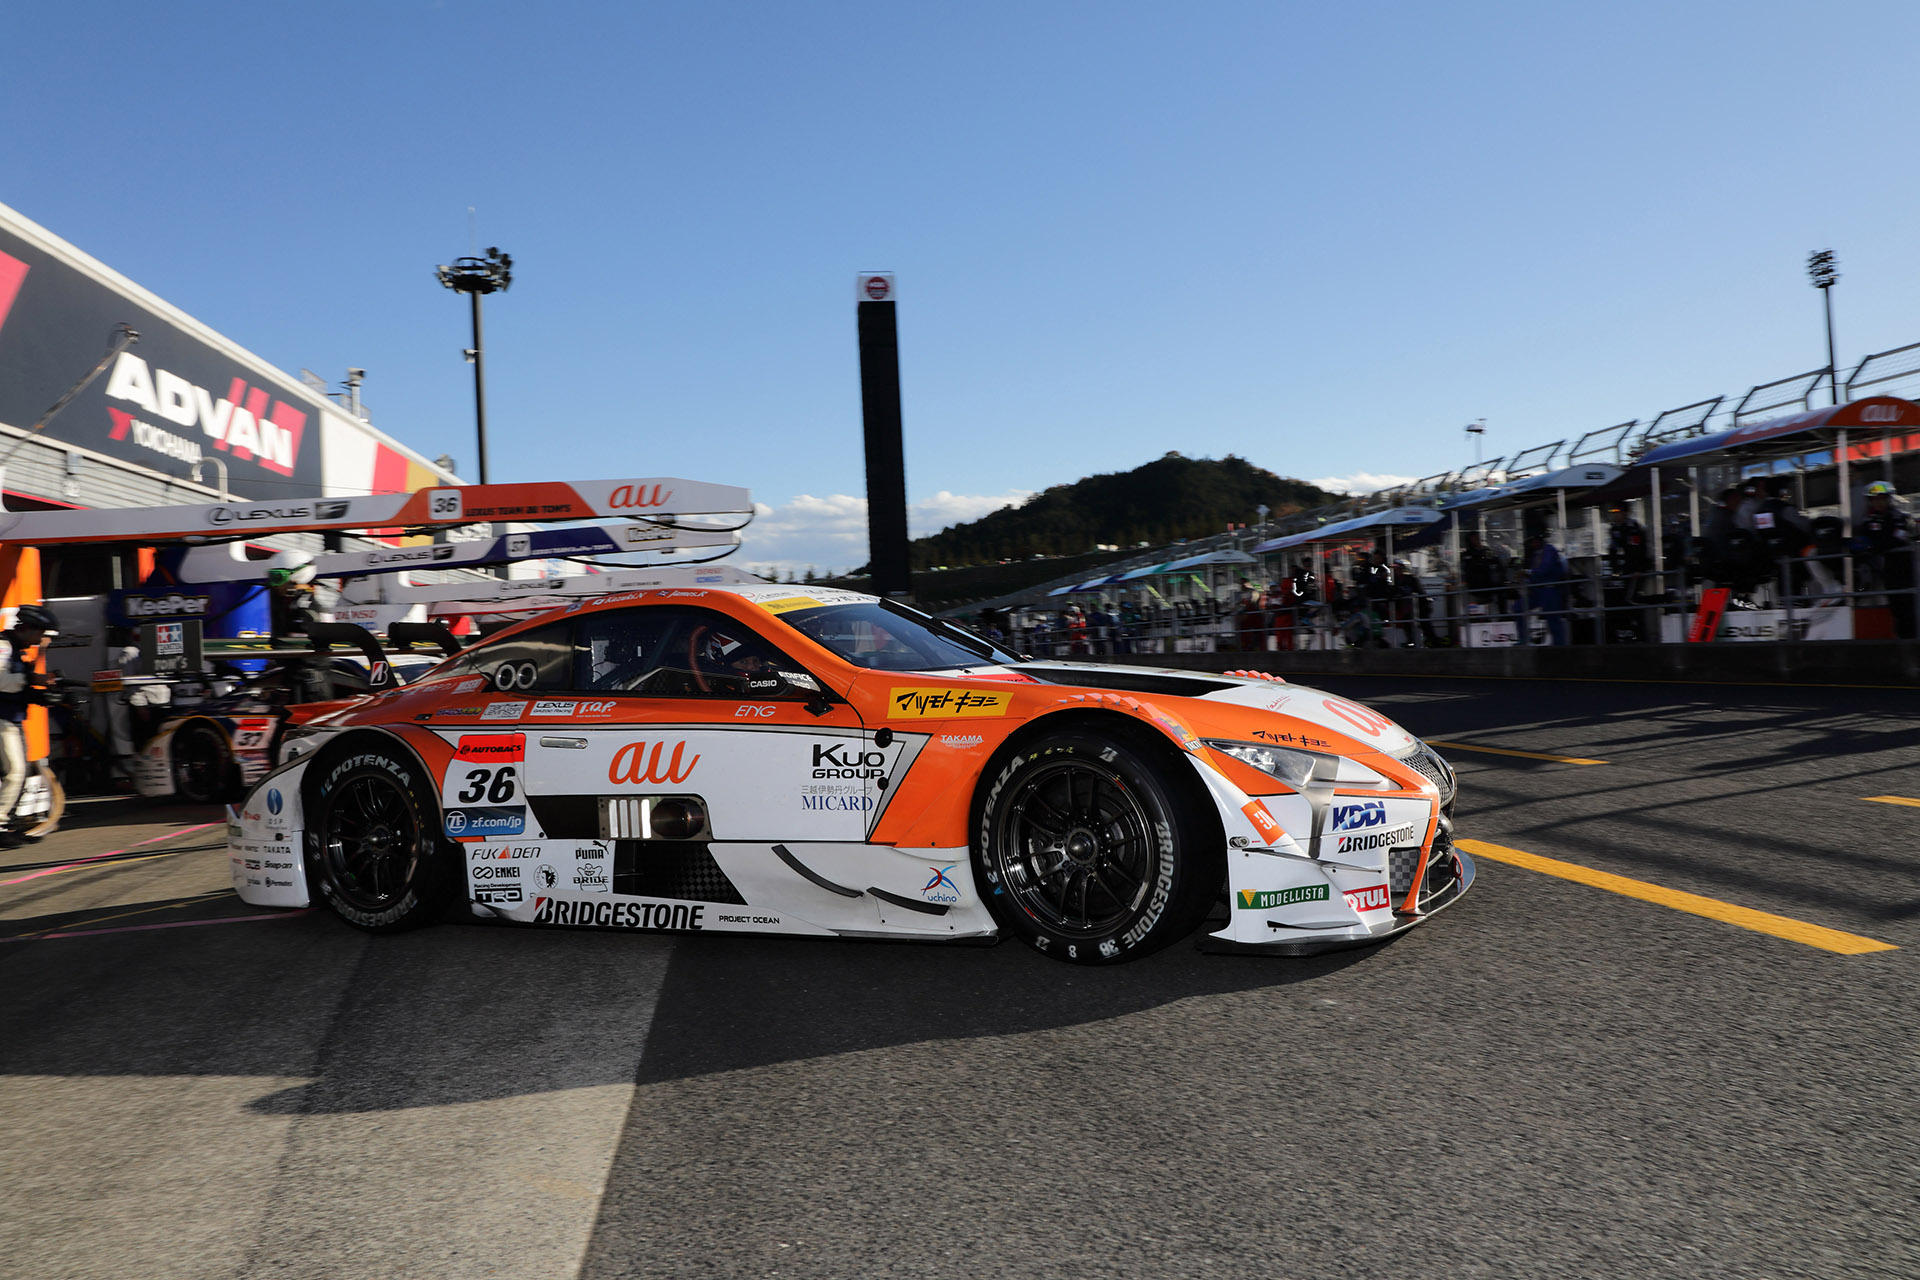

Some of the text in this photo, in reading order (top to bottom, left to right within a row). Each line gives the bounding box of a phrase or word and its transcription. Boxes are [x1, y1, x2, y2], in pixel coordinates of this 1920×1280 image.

[105, 351, 294, 469] ADVAN
[433, 497, 458, 513] 36
[608, 484, 673, 509] au
[236, 507, 311, 521] LEXUS
[127, 594, 209, 616] KeePer
[750, 679, 778, 688] CASIO
[896, 690, 999, 715] マツモトキヨシ
[471, 744, 522, 754] AUTOBACS
[332, 754, 411, 788] POTENZA
[608, 741, 701, 785] au
[812, 768, 885, 779] GROUP
[458, 766, 516, 804] 36
[802, 795, 873, 811] MICARD
[981, 755, 1025, 867] POTENZA
[471, 816, 522, 829] zf.com/jp
[1332, 801, 1386, 831] KDDI
[1338, 825, 1414, 854] BRIDGESTONE
[575, 849, 604, 859] PUMA
[495, 867, 520, 878] ENKEI
[573, 876, 609, 884] BRIDE
[1121, 820, 1174, 949] BRIDGESTONE
[476, 889, 520, 903] TRD
[927, 892, 957, 903] uchino
[1260, 887, 1325, 907] MODELLISTA
[533, 897, 704, 930] BRIDGESTONE
[719, 915, 780, 924] PROJECT OCEAN
